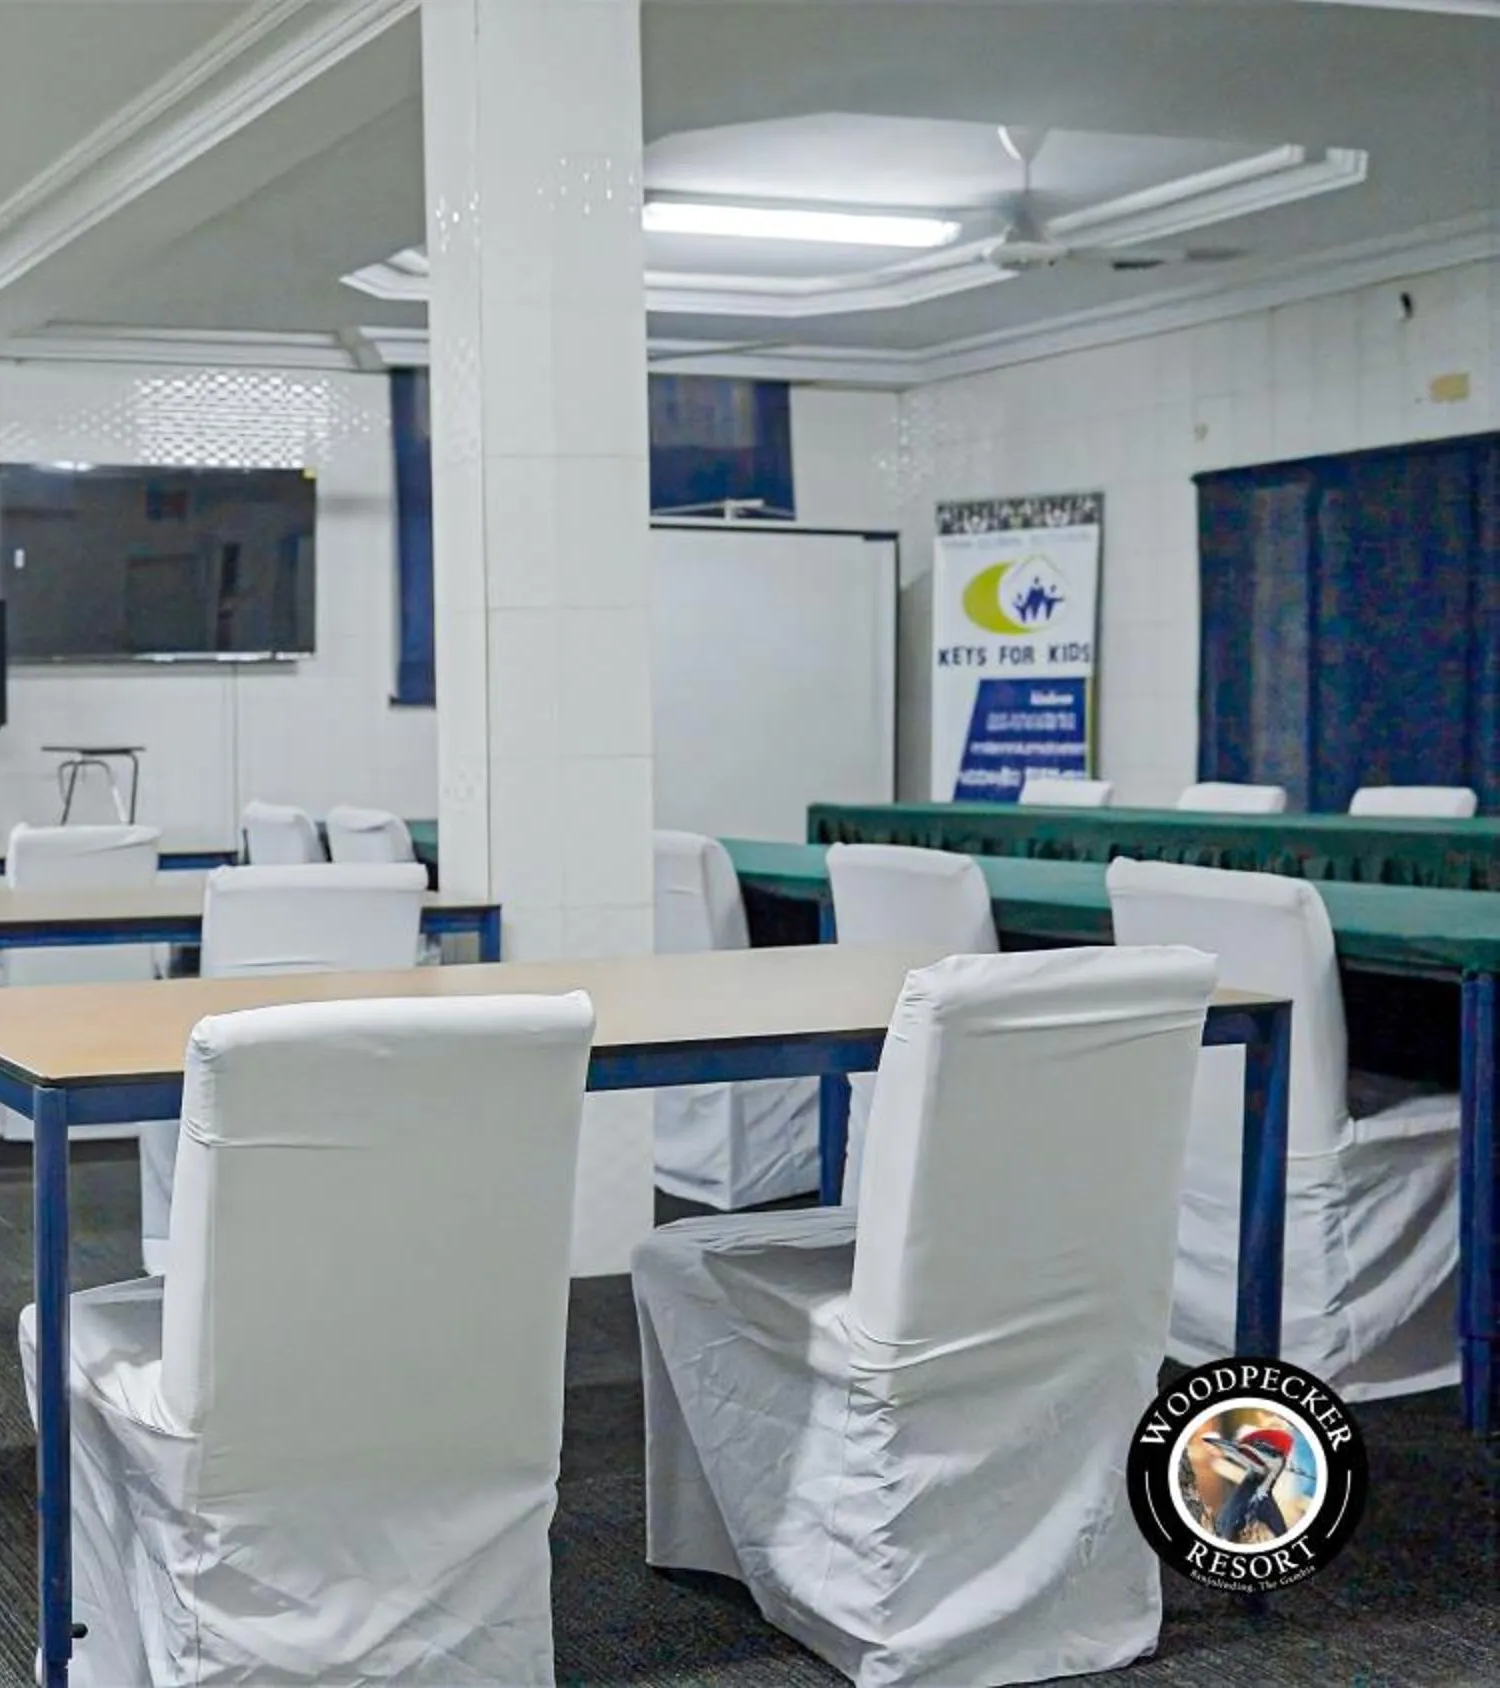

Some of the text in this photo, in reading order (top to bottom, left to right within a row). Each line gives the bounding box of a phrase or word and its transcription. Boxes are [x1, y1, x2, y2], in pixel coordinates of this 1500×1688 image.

[938, 642, 1090, 667] KEYS FOR KIDS
